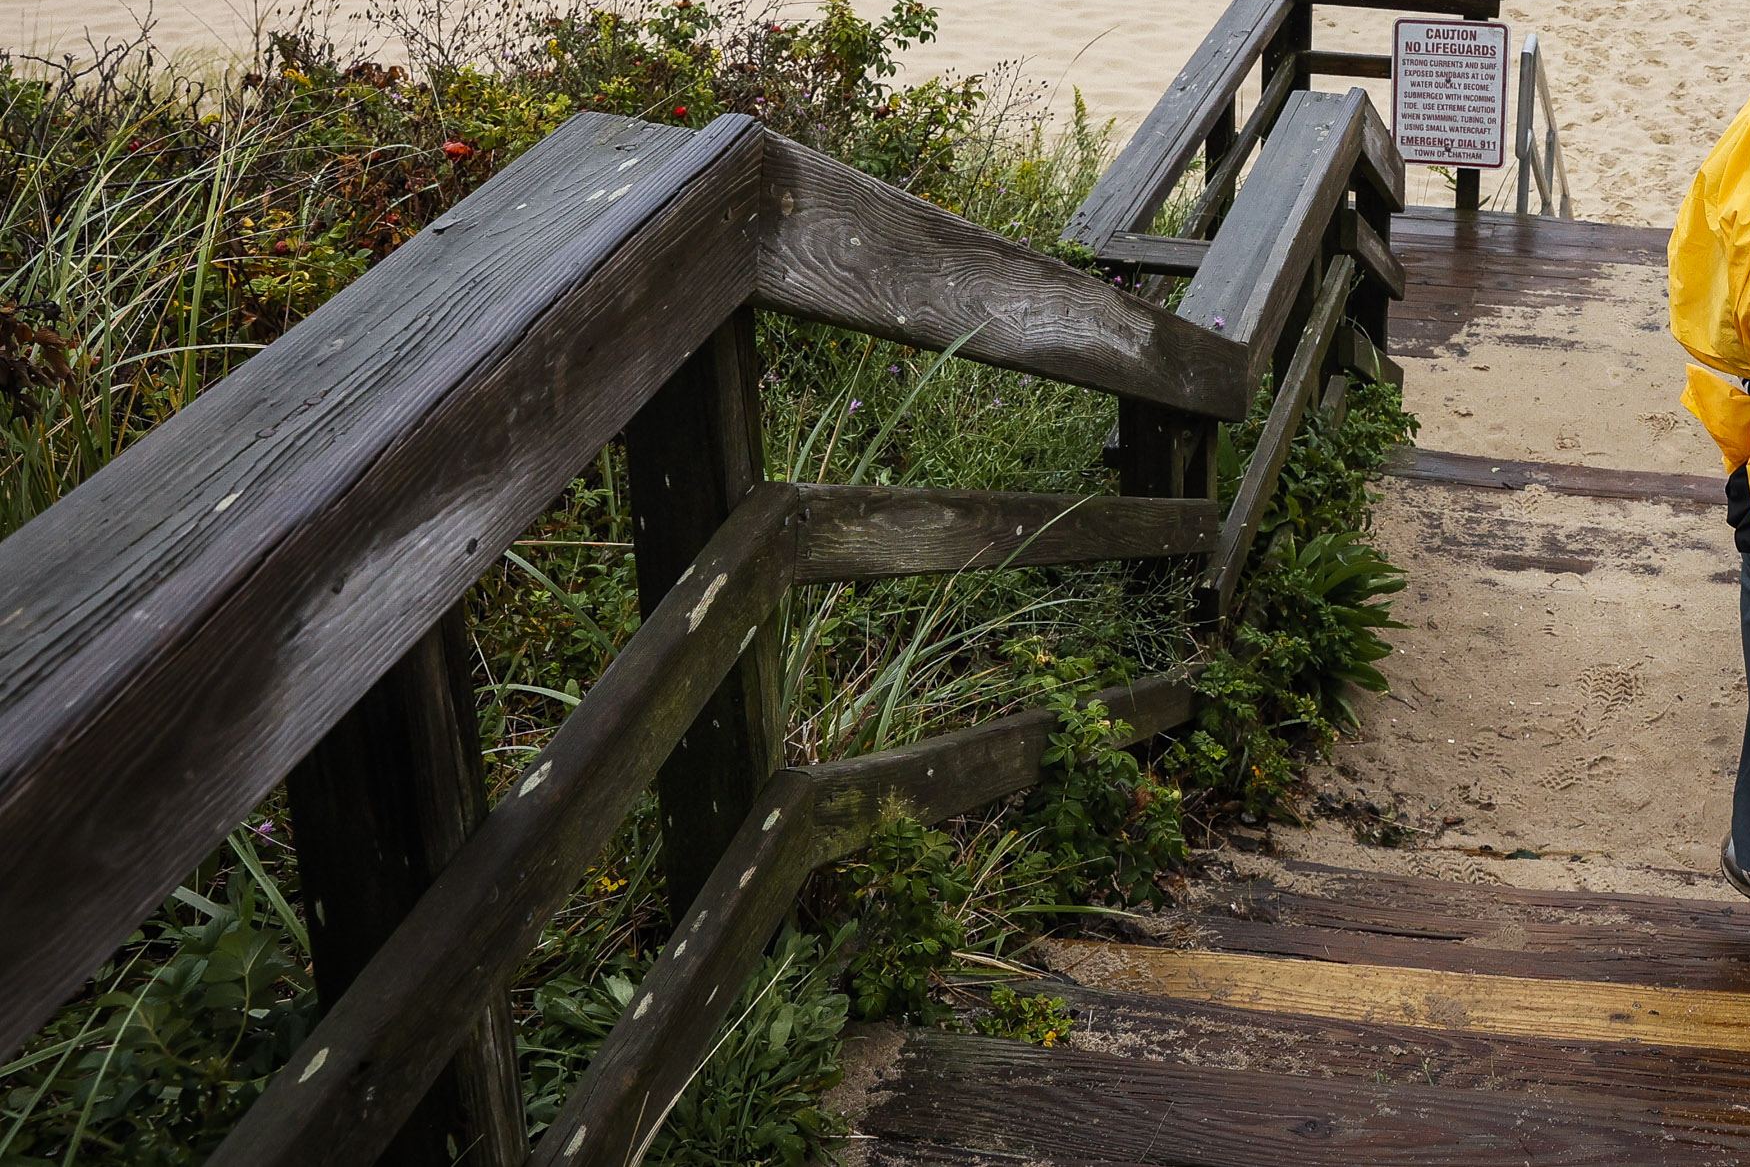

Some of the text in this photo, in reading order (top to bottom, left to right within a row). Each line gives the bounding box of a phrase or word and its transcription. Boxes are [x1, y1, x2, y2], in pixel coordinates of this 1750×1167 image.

[1426, 29, 1476, 41] CAUTION
[1406, 42, 1496, 56] NO LIFEGUARDS
[1430, 60, 1463, 68] CURRENTS
[1435, 71, 1469, 79] SANDBARS
[1404, 92, 1443, 100] SUBMERGED
[1463, 95, 1495, 103] INCOMING
[1401, 136, 1496, 149] EMERGENCY DIAL 911
[1448, 151, 1482, 159] CHATHAM
